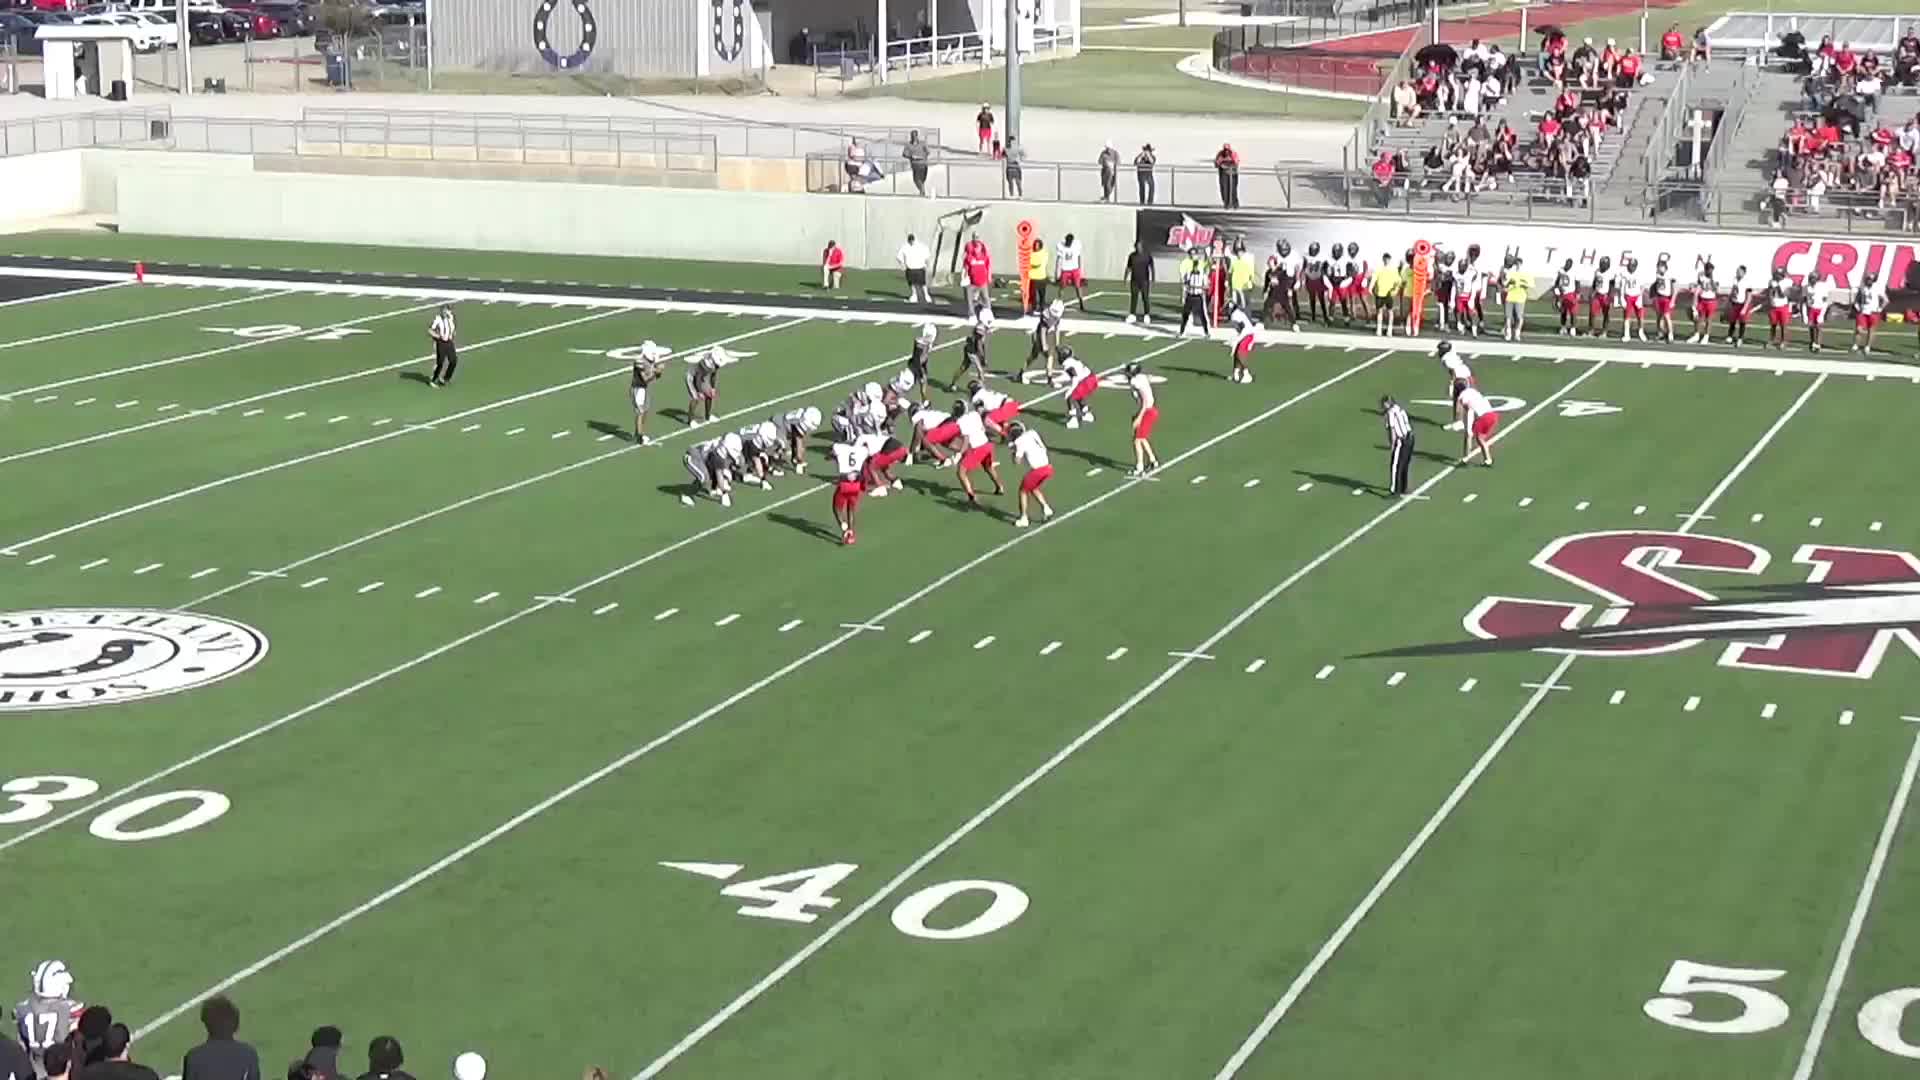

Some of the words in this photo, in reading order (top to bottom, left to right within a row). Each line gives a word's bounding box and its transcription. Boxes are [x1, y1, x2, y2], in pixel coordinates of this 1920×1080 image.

[849, 452, 857, 467] 6
[720, 863, 1030, 939] 40
[25, 1012, 58, 1049] 17
